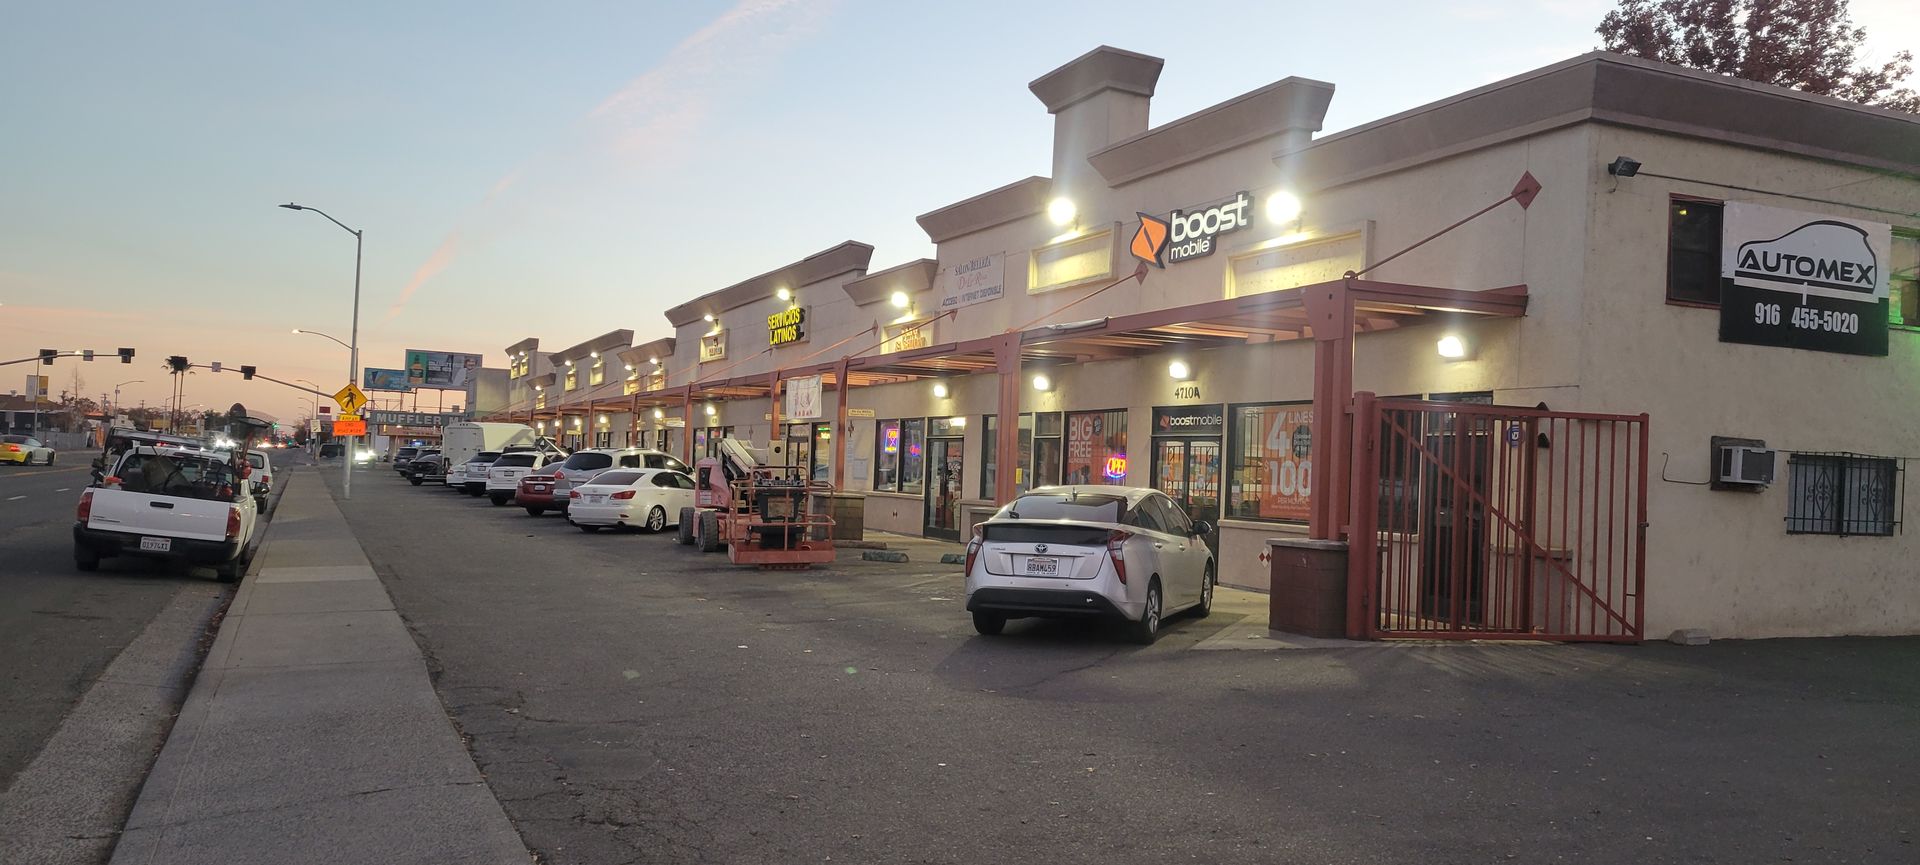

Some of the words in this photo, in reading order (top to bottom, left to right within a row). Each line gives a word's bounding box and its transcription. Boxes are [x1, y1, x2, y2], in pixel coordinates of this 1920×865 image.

[1170, 193, 1248, 243] boost
[1171, 237, 1210, 260] mobile
[1738, 249, 1874, 285] AUTOMEX
[768, 308, 800, 330] SERVICIOS
[1754, 302, 1781, 326] 916
[1791, 306, 1859, 335] 455-5020
[770, 324, 797, 345] LATINOS
[1174, 386, 1200, 399] 4710A
[376, 413, 442, 425] MUFFLER
[1069, 416, 1093, 441] BIG
[1266, 411, 1290, 458] 4
[1068, 441, 1092, 458] FREE
